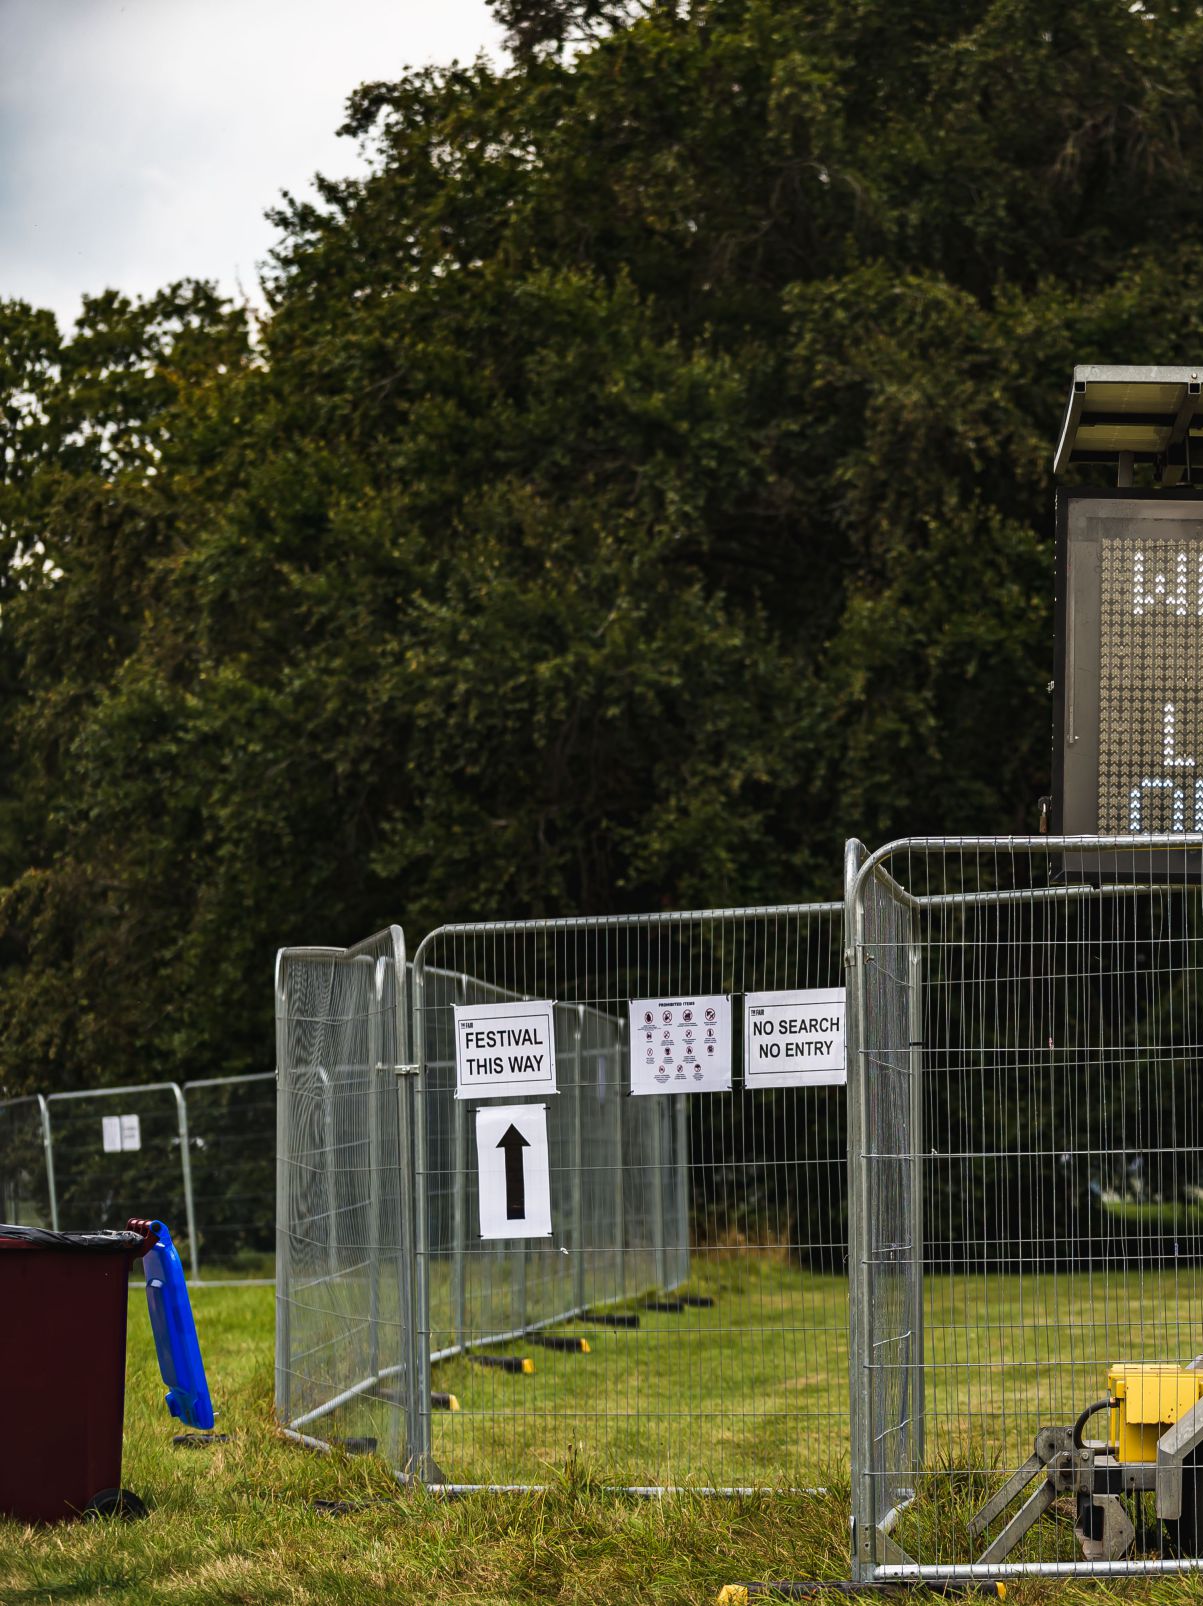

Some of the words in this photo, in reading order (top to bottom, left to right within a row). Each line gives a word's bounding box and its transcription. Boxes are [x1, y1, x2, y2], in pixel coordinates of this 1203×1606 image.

[753, 1020, 774, 1036] NO
[778, 1017, 840, 1035] SEARCH
[465, 1028, 543, 1049] FESTIVAL
[759, 1043, 781, 1059] NO
[785, 1040, 833, 1057] ENTRY
[466, 1057, 504, 1076] THIS
[508, 1054, 544, 1073] WAY
